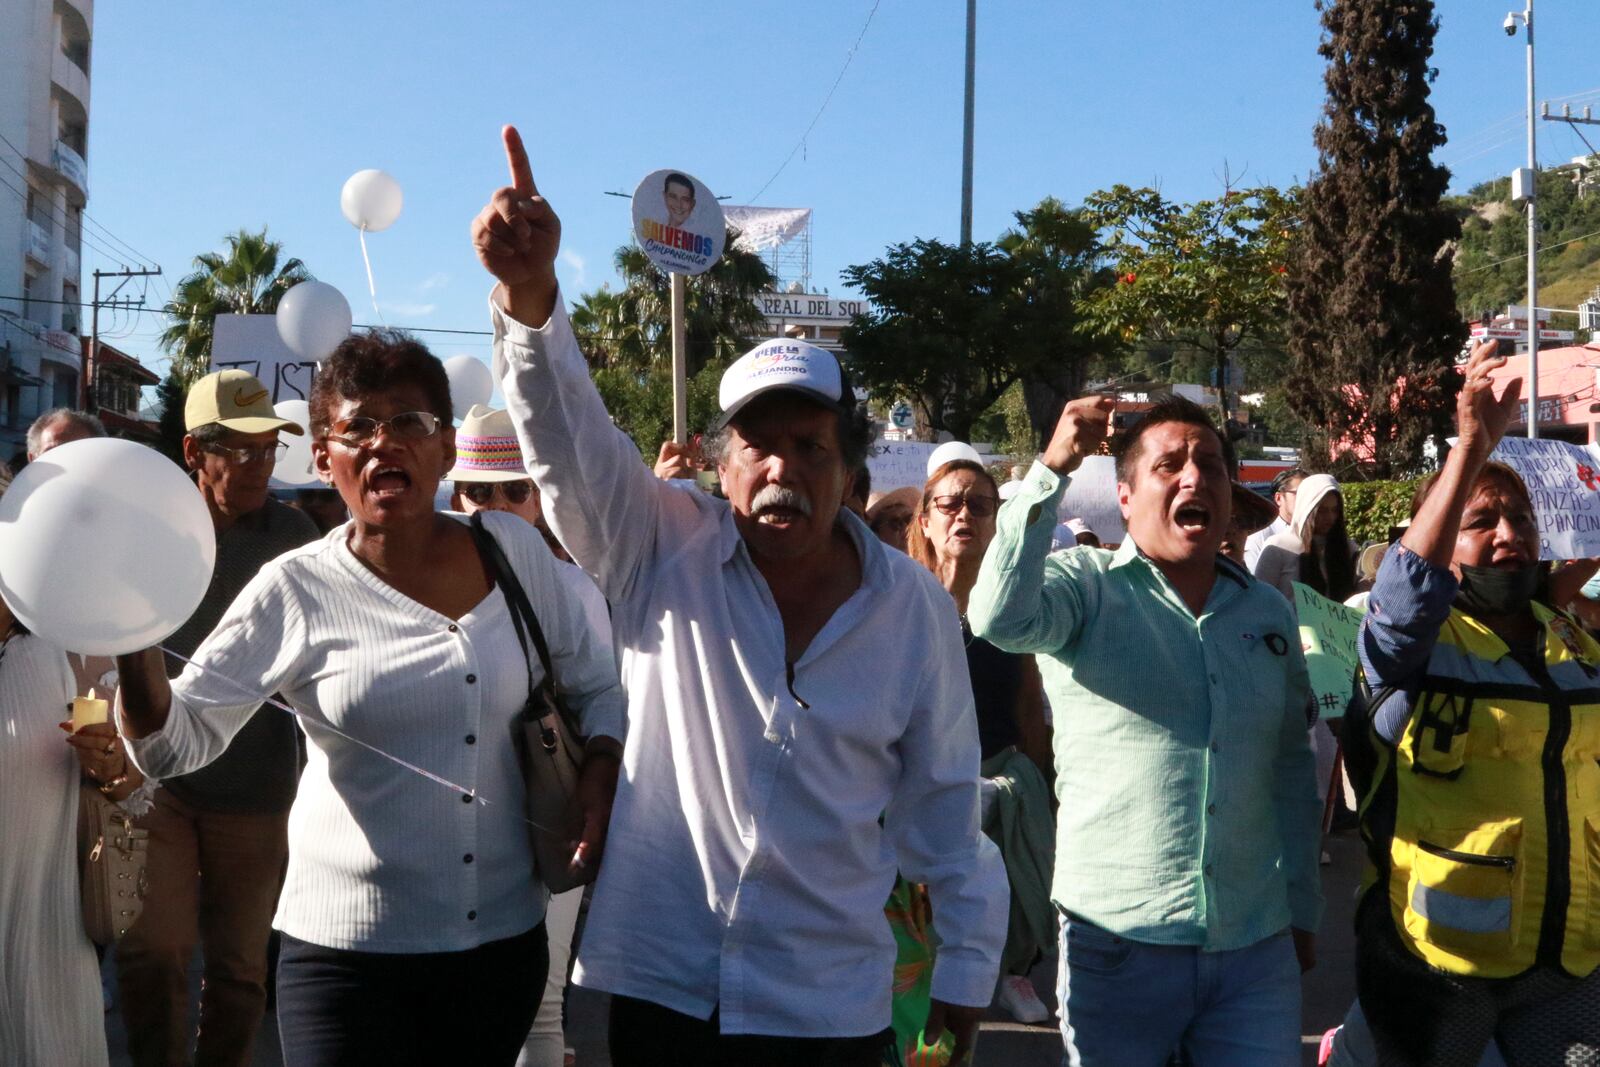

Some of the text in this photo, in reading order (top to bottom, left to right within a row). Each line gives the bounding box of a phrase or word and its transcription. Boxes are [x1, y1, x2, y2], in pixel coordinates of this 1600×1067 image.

[642, 218, 713, 256] SALVEMOS
[764, 299, 801, 314] REAL
[808, 300, 831, 316] DEL
[786, 346, 799, 354] LA
[1302, 588, 1322, 610] NO
